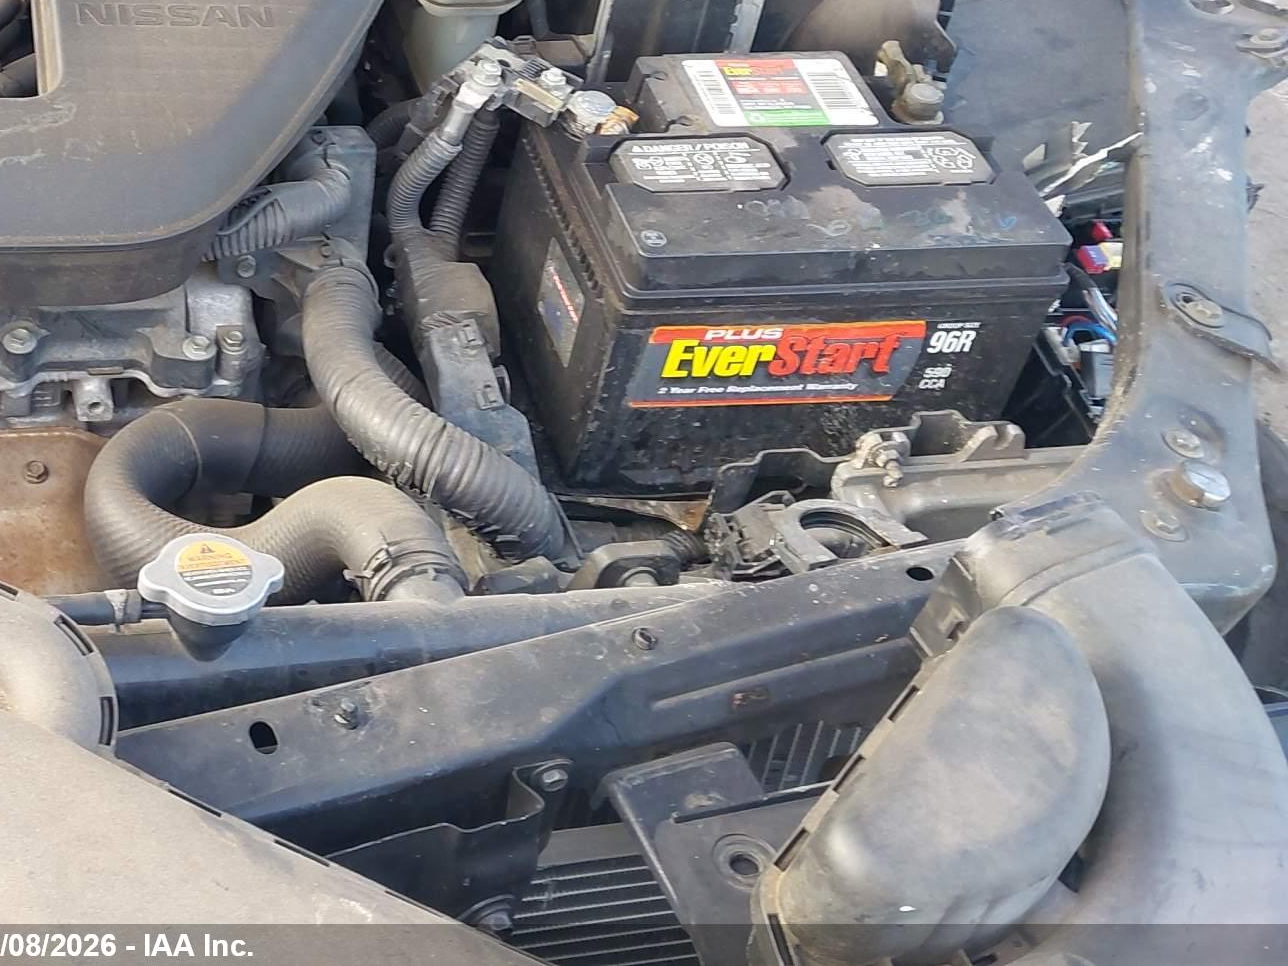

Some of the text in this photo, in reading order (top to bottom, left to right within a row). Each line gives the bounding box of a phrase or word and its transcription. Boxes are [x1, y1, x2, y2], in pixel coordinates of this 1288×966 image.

[75, 2, 275, 28] NISSAN
[704, 328, 783, 341] PLUS
[926, 330, 977, 353] 96R
[661, 335, 900, 378] EverStart
[669, 386, 697, 395] Year
[697, 385, 725, 394] Free
